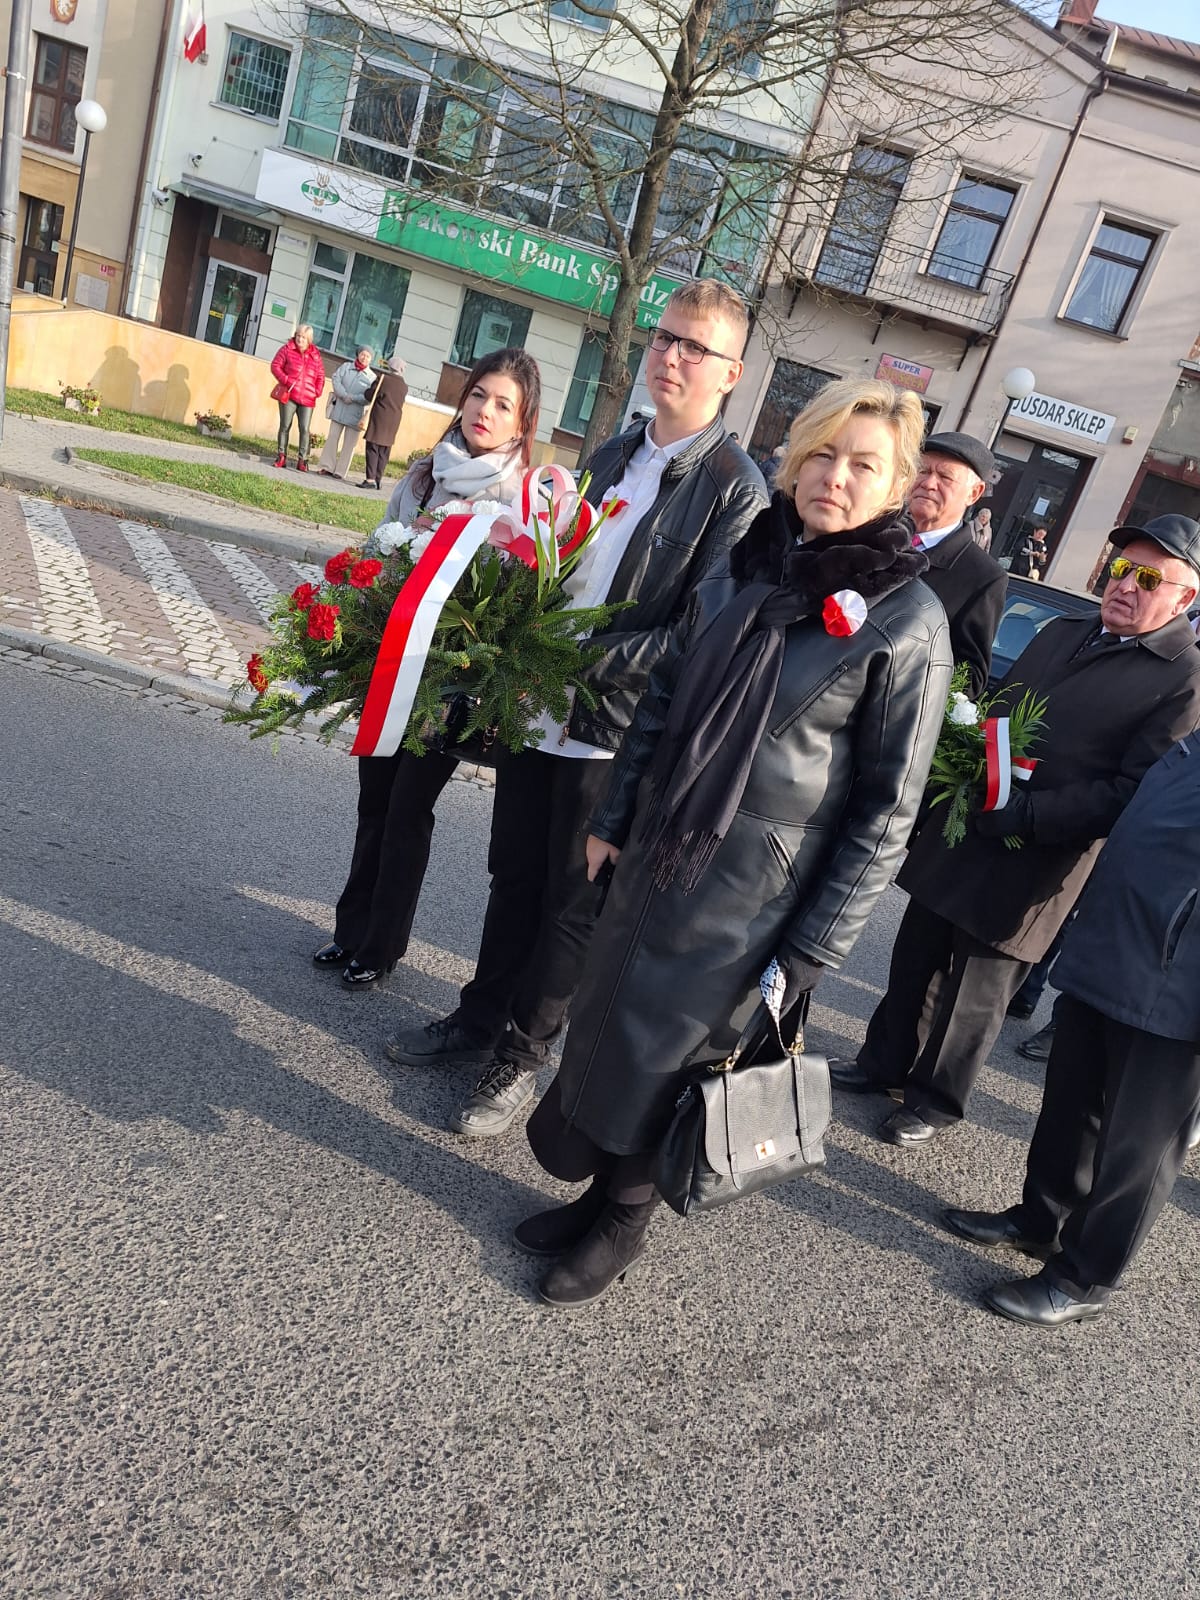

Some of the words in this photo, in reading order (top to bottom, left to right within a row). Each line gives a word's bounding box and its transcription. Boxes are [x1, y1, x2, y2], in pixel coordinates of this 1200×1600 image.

[385, 194, 515, 257] Krakowski
[519, 238, 582, 280] Bank
[892, 360, 921, 375] SUPER
[1063, 408, 1106, 435] SKLEP
